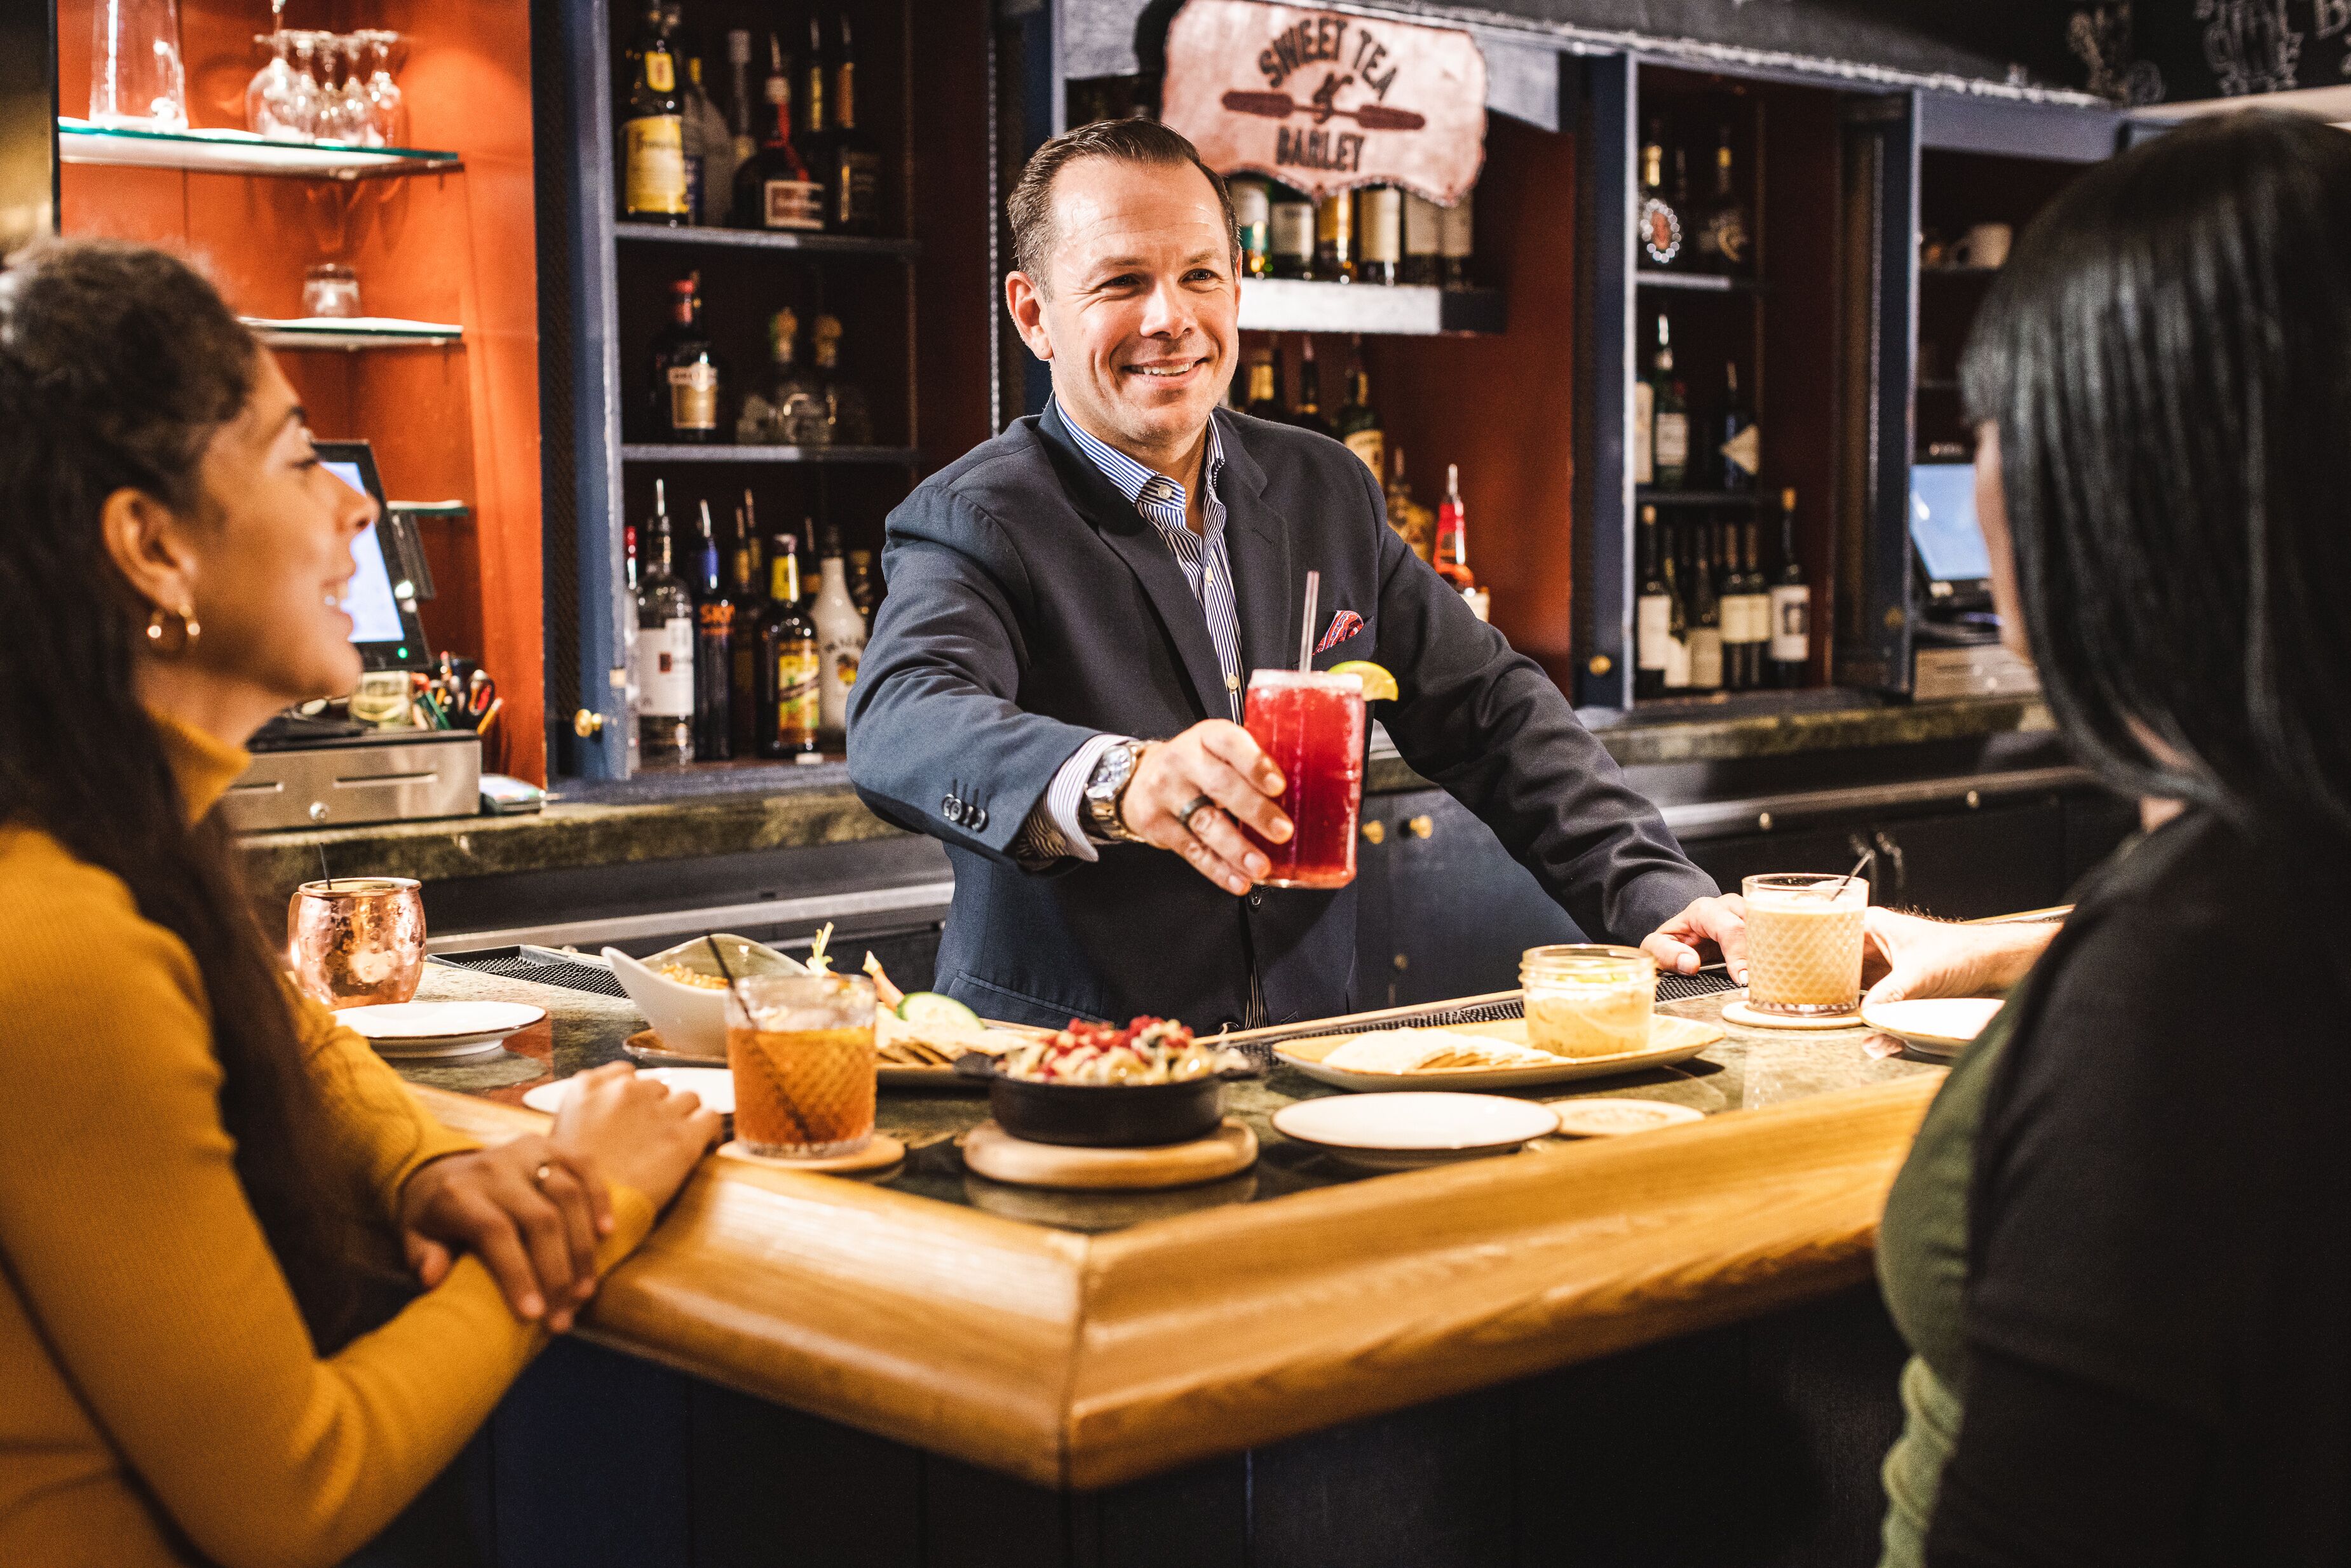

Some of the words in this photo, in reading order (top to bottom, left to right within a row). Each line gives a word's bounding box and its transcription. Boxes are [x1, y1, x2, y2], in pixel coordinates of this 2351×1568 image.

[1259, 17, 1348, 88] SWEET
[1353, 29, 1397, 101] TEA
[1275, 125, 1365, 172] BARLEY
